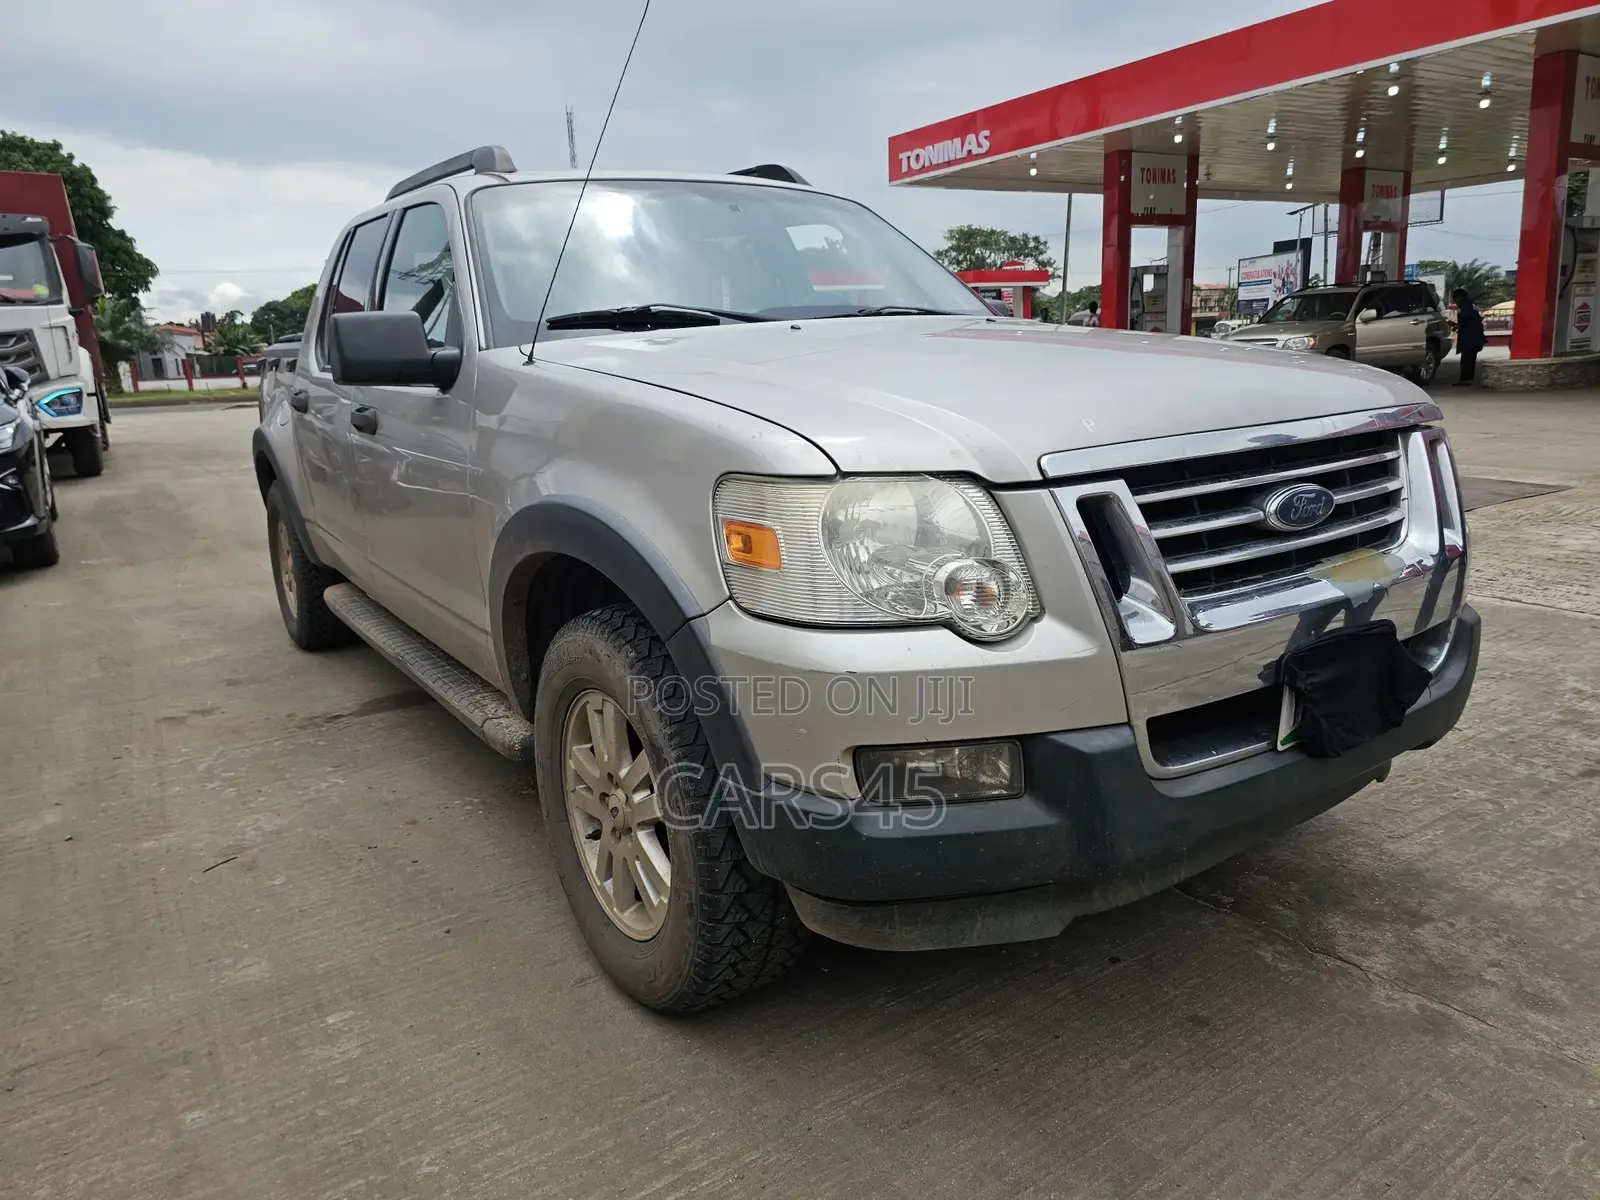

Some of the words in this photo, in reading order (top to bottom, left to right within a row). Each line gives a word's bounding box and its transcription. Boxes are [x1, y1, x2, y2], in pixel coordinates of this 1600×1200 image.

[899, 130, 990, 173] TONIMAS
[1140, 167, 1176, 184] TONIMAS
[1291, 493, 1325, 520] Ford
